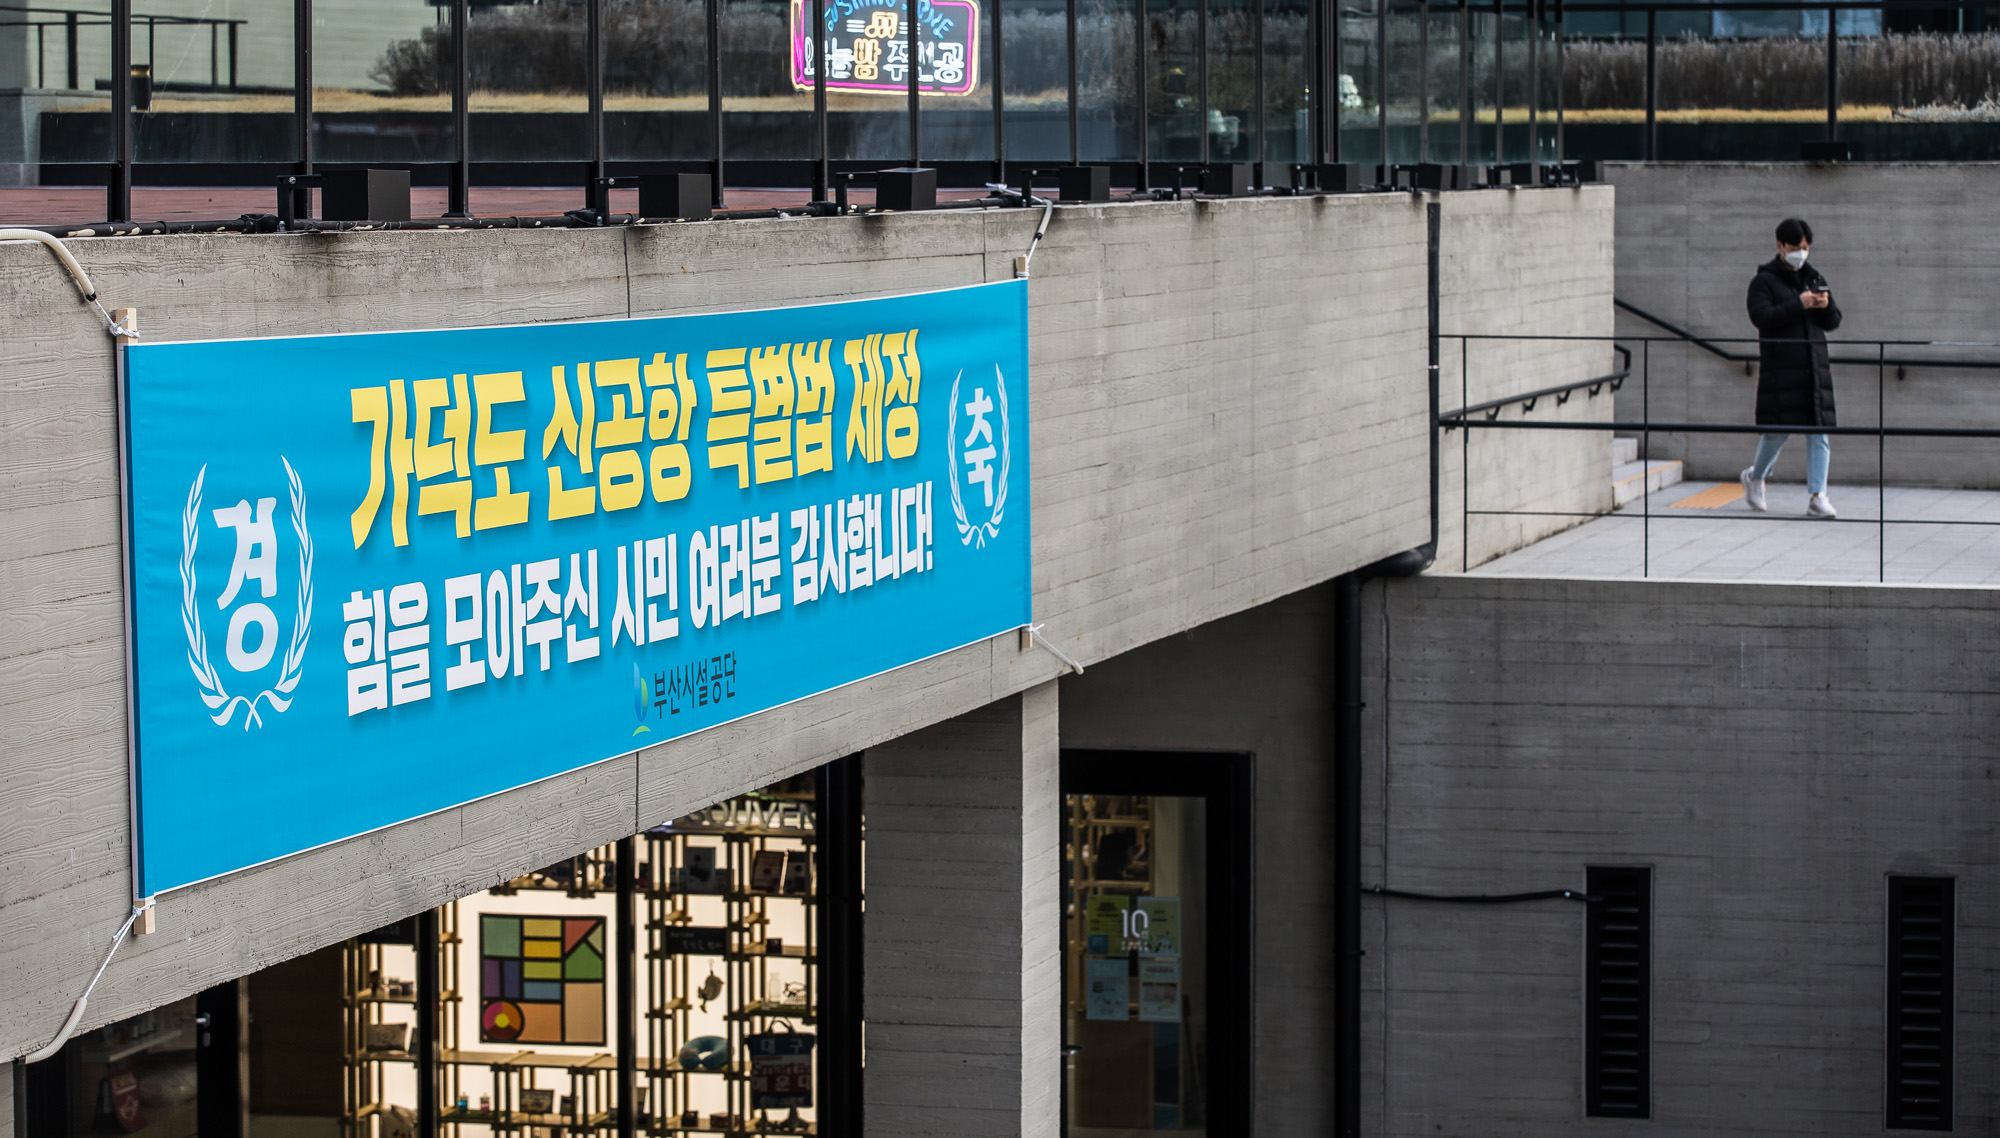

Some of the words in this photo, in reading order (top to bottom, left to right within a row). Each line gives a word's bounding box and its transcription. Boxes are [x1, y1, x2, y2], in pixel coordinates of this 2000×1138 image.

[350, 370, 531, 550] 가덕도
[542, 351, 698, 521] 신공항
[704, 338, 836, 490] 특별법
[843, 328, 921, 464] 제정
[963, 387, 997, 507] 축
[212, 497, 279, 673] 경
[342, 581, 432, 717] 힘을
[444, 548, 600, 692] 모아주신
[611, 533, 680, 649] 시민
[688, 511, 782, 630] 여러분
[790, 480, 934, 606] 감사합니다!
[653, 650, 737, 720] 부산시설공단
